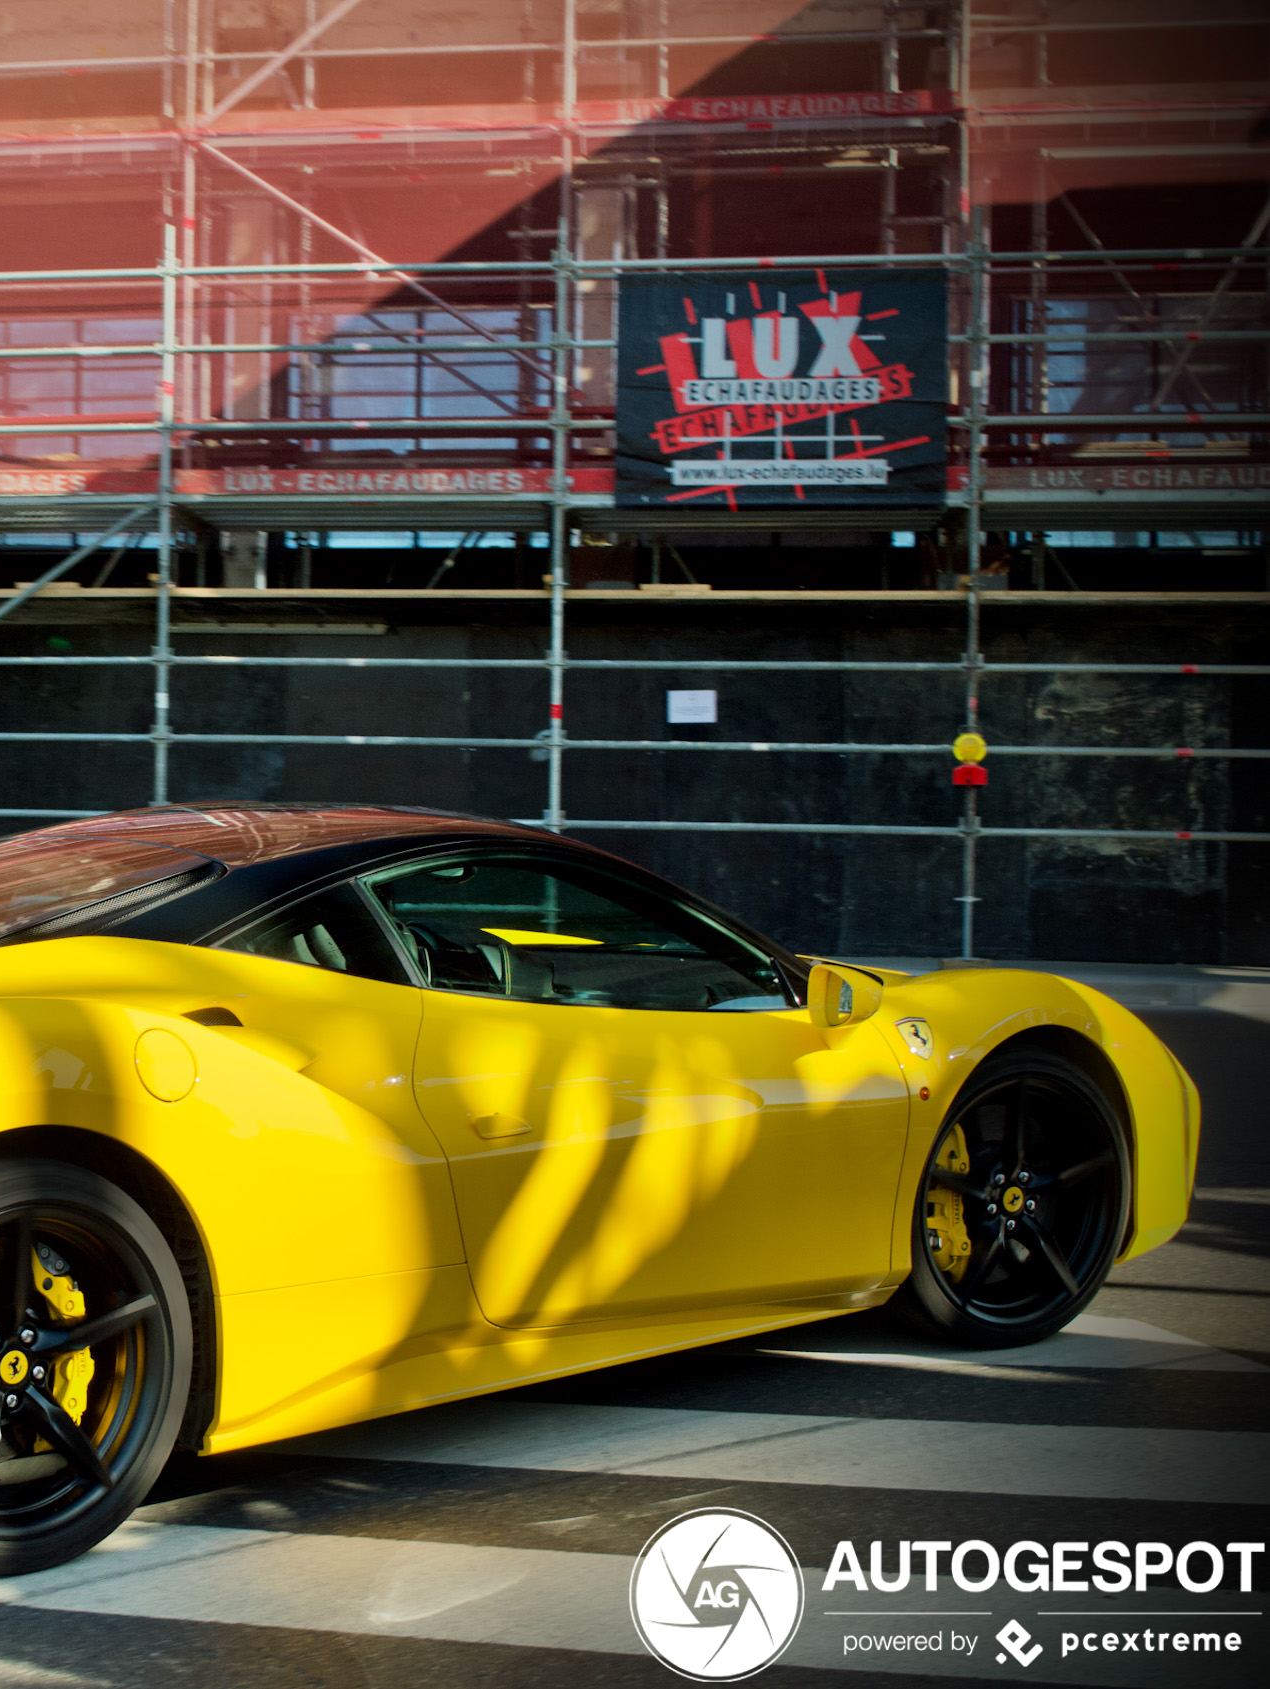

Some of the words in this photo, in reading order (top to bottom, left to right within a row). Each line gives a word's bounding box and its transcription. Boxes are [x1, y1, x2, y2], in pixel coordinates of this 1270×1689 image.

[692, 92, 919, 119] ECHAFAUDAGES
[701, 316, 862, 379] LUX
[688, 380, 876, 402] ECHAFAUDAGES
[225, 472, 276, 491] LUX
[299, 470, 524, 491] ECHAFAUDAGES
[681, 464, 885, 482] www.lux-echafaudages.lu
[1031, 470, 1085, 488] LUX
